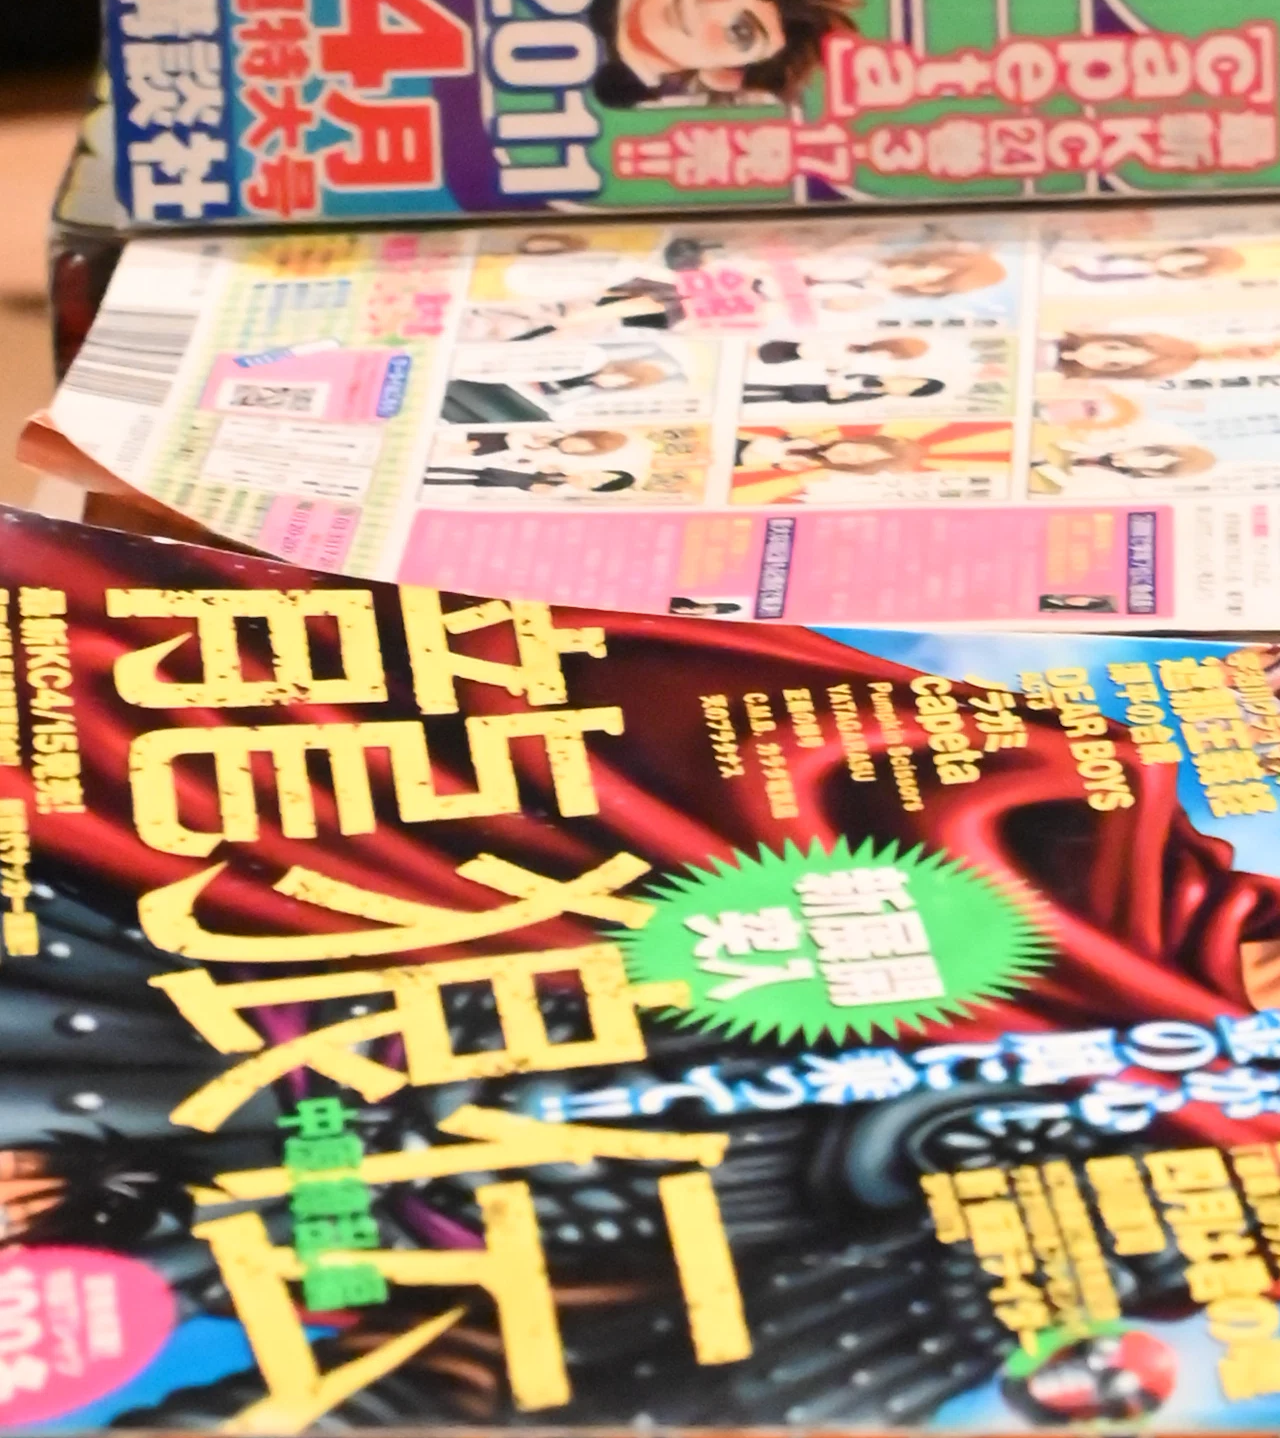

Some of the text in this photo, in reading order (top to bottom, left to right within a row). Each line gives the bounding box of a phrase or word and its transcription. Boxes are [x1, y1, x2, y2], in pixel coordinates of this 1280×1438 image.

[824, 682, 878, 784] YATAGARASU
[865, 681, 929, 813] Pumpkin Scissors
[962, 672, 1032, 756] ノラガミ
[1042, 666, 1136, 813] DEAR BOYS
[682, 906, 814, 1004] 突入
[795, 864, 947, 1009] 新展開
[108, 582, 760, 1436] 龍狼伝
